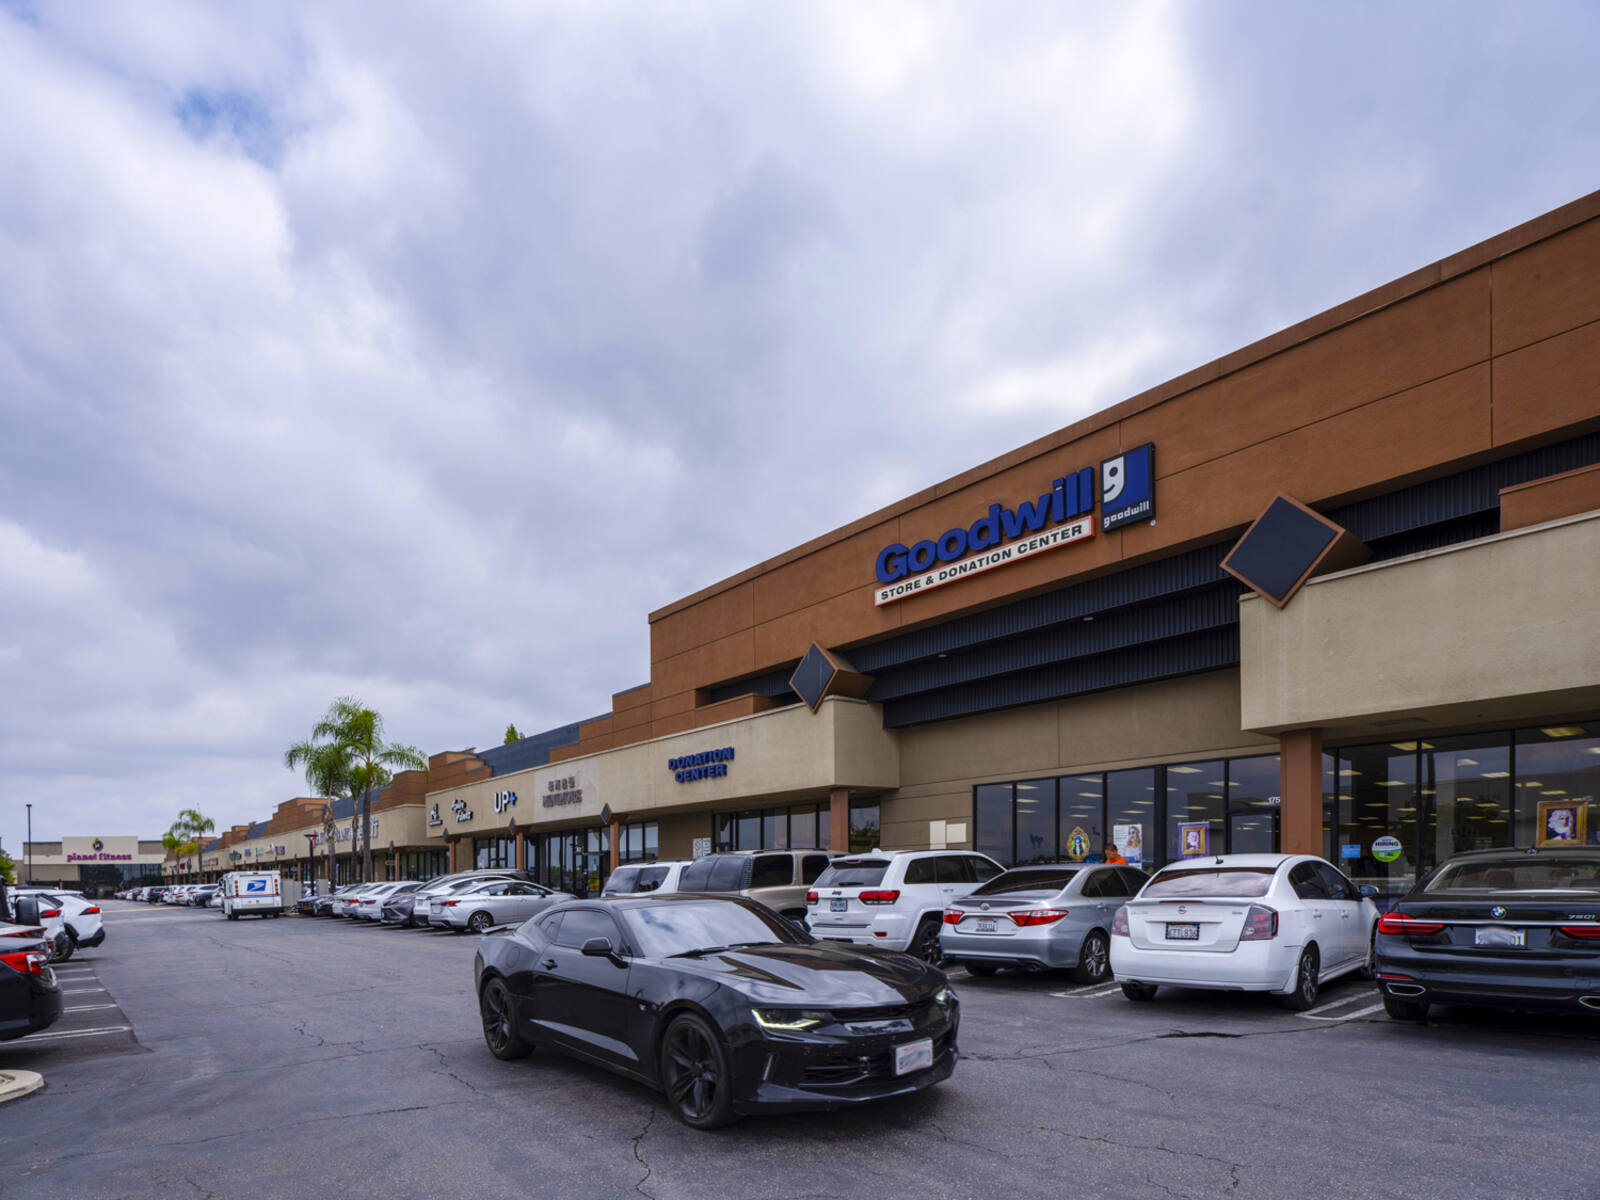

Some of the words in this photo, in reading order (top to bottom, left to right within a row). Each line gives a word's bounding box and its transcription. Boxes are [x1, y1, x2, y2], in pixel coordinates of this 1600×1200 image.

[875, 466, 1095, 583] Goodwill
[1104, 500, 1149, 528] goodwill
[881, 581, 921, 600] STORE
[925, 575, 935, 586] &
[939, 548, 1012, 581] DONATION
[1017, 524, 1083, 554] CENTER
[668, 746, 735, 770] DONATION
[675, 763, 728, 783] CENTER
[66, 852, 97, 863] planet
[99, 852, 132, 861] fitness
